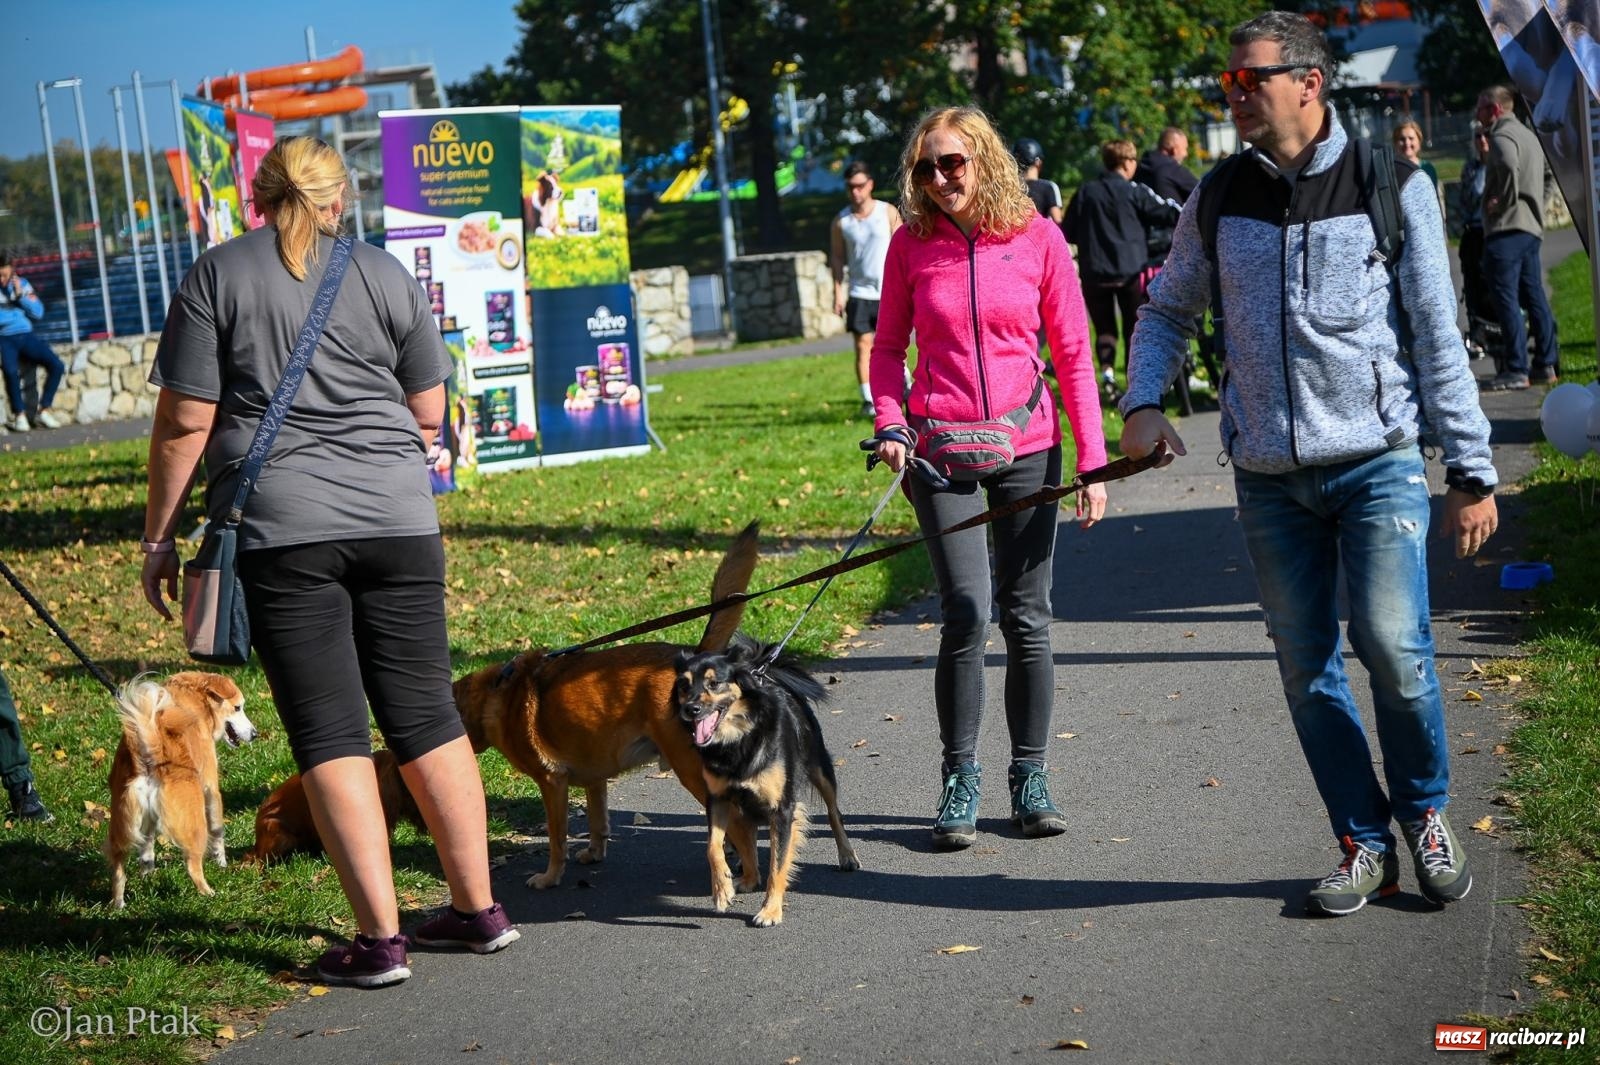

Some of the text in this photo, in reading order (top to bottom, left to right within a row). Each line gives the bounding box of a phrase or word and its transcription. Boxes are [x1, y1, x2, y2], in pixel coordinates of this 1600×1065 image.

[413, 141, 494, 168] nuevo
[474, 184, 490, 193] food
[587, 315, 628, 330] nuevo
